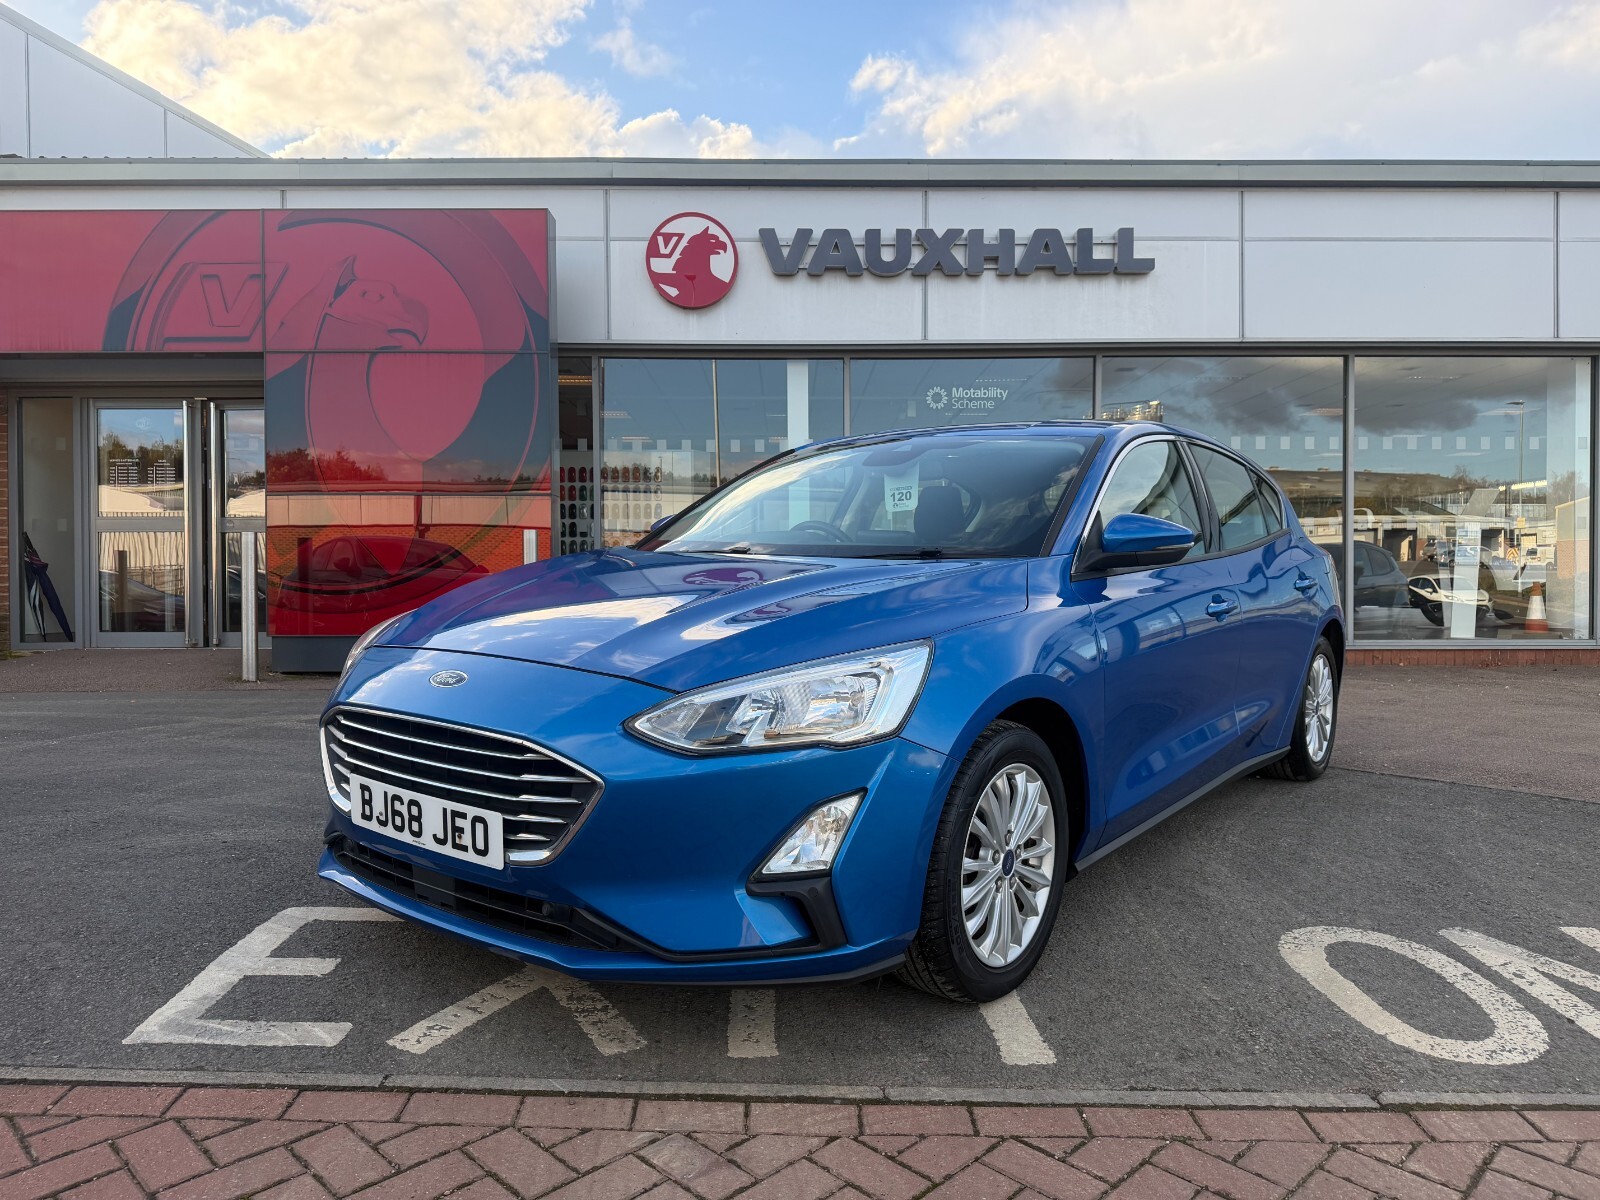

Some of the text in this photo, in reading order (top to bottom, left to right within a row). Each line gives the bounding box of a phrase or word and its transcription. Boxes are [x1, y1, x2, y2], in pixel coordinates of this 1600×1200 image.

[758, 227, 1156, 277] VAUXHALL
[951, 387, 1009, 401] Motability
[951, 398, 995, 409] Scheme
[890, 491, 912, 502] 120
[359, 782, 490, 858] BJ68 JEO
